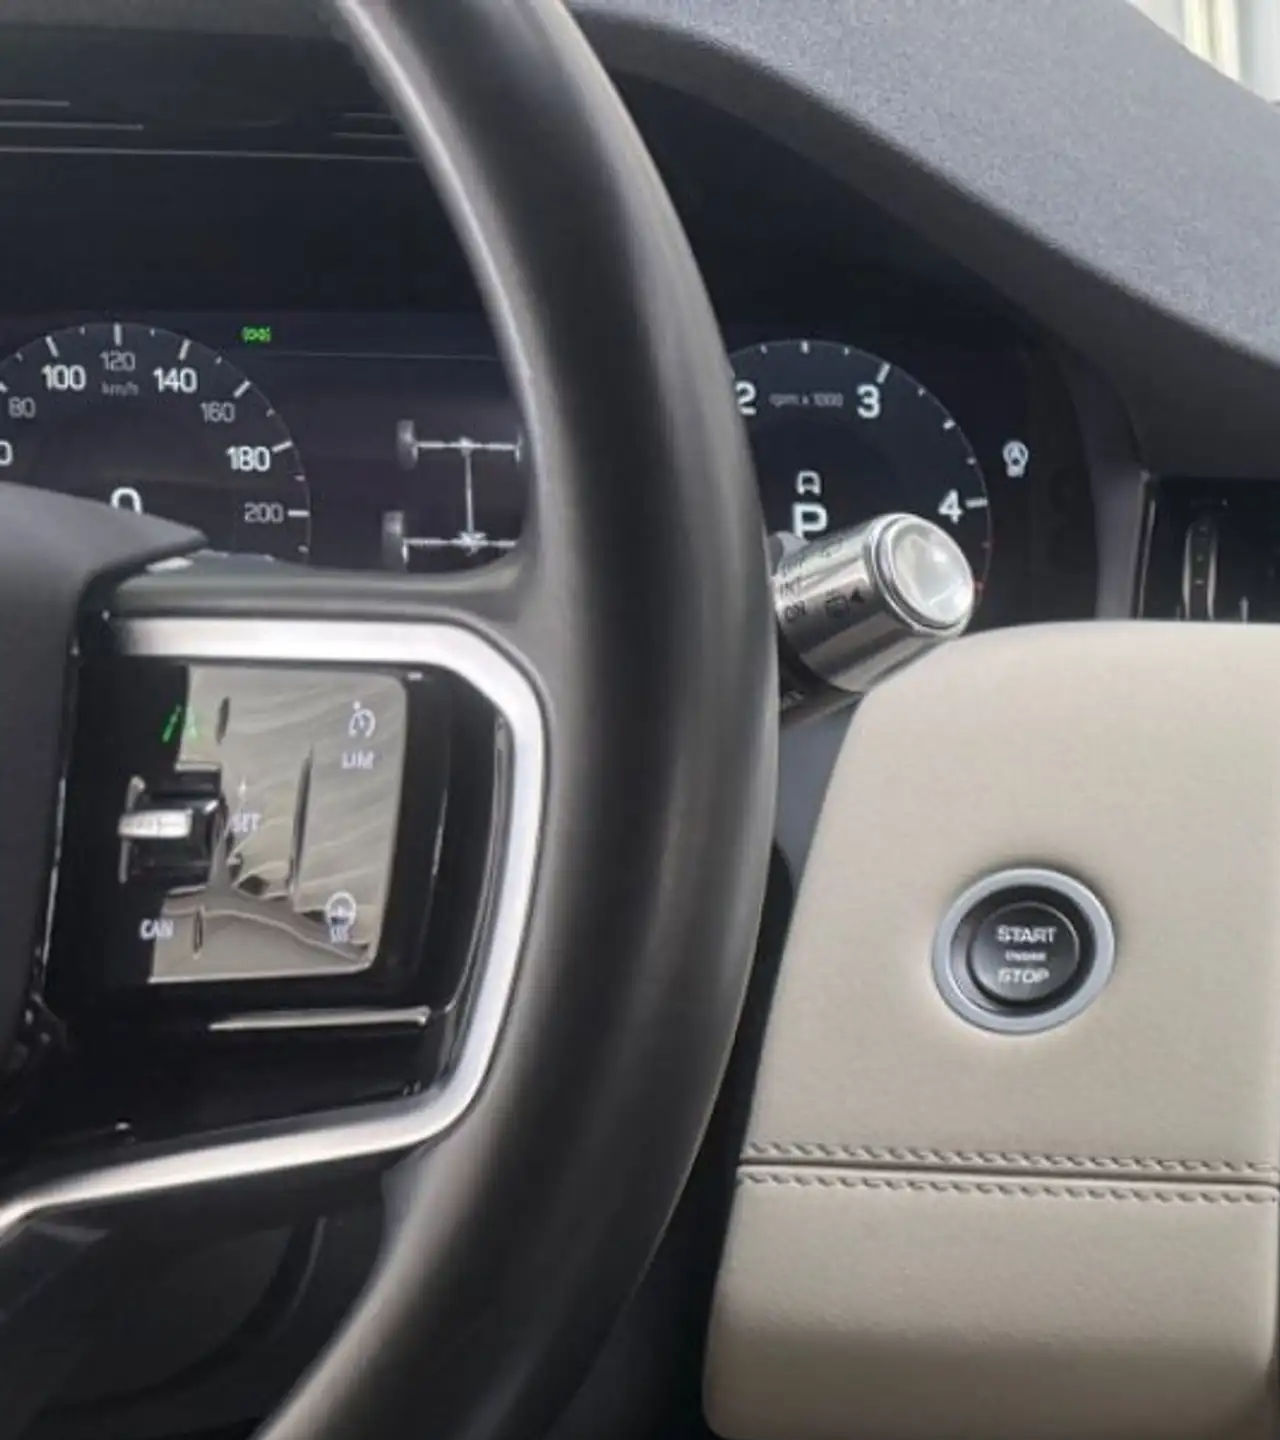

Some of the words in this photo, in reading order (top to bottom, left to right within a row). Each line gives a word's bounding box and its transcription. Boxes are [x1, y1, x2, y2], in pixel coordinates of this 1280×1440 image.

[100, 349, 136, 372] 120
[42, 364, 87, 391] 100
[153, 367, 198, 393] 140
[735, 382, 757, 415] 2
[857, 384, 881, 418] 3
[200, 401, 236, 423] 160
[227, 445, 271, 472] 180
[244, 503, 284, 524] 200
[938, 490, 963, 524] 4
[140, 918, 174, 939] CAN
[997, 925, 1057, 943] START
[999, 968, 1050, 983] STOP
